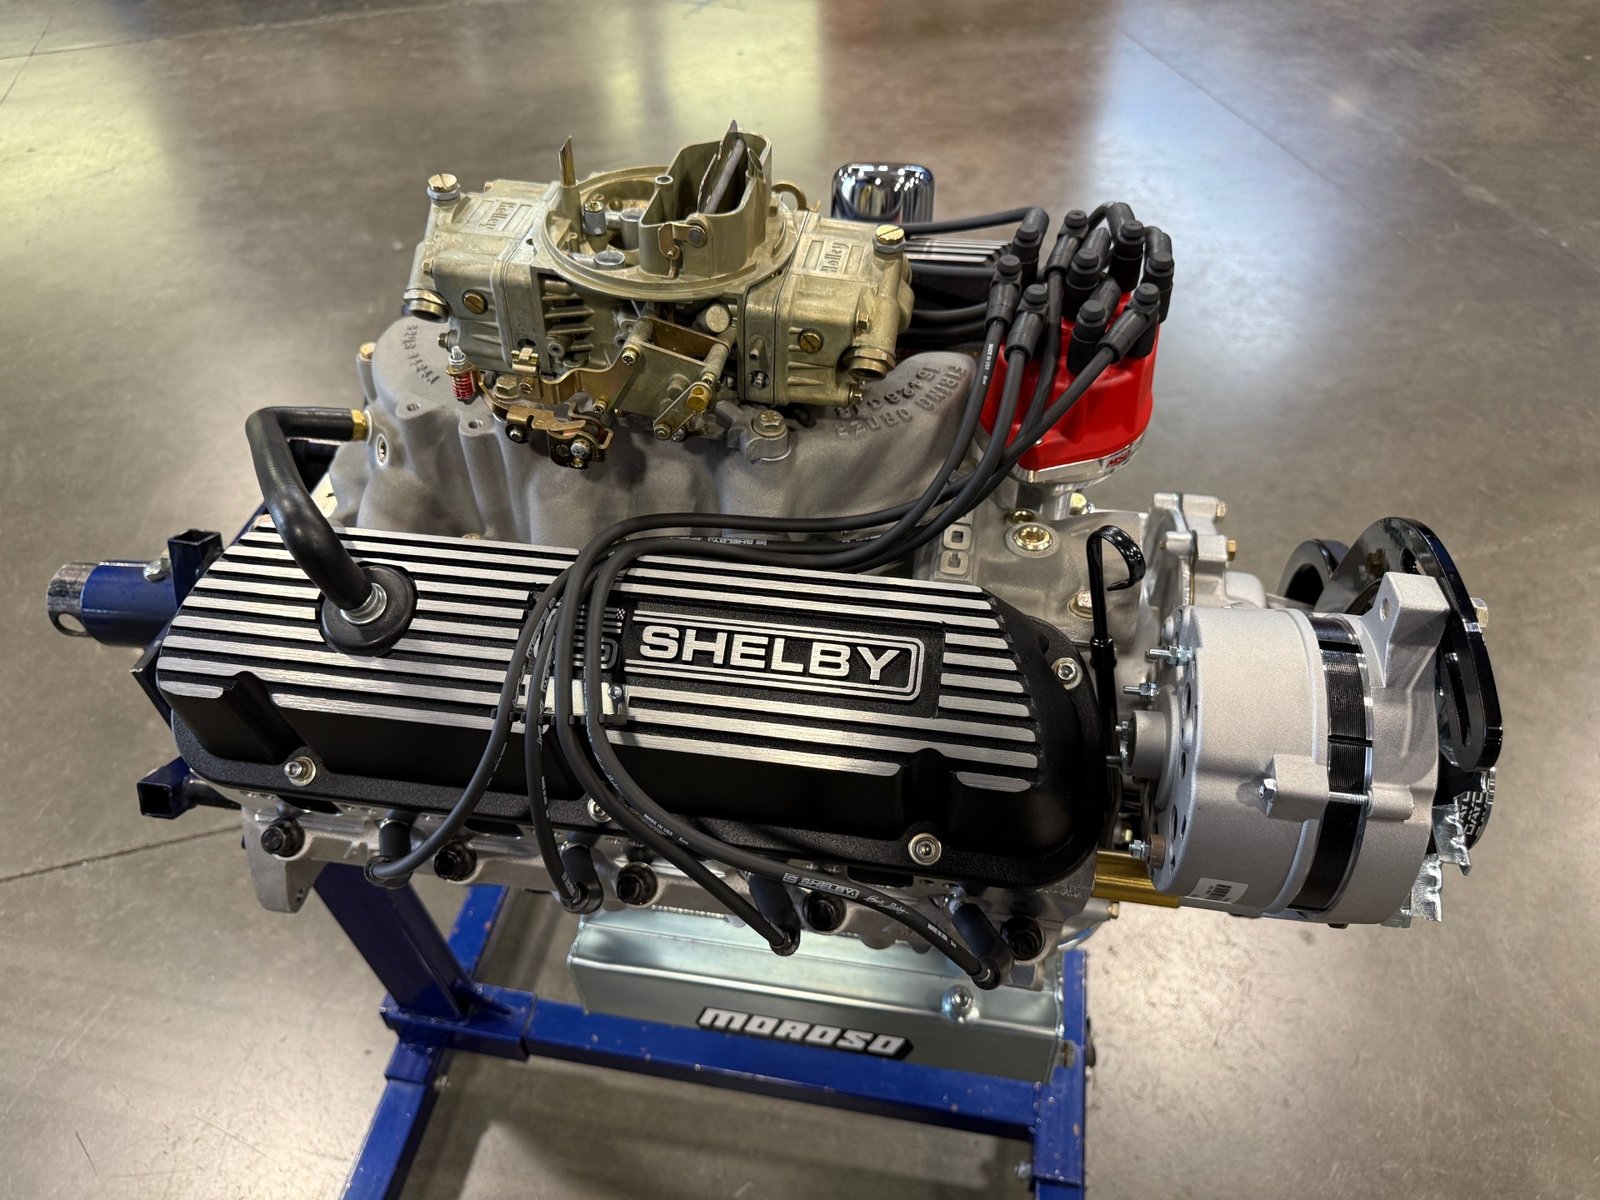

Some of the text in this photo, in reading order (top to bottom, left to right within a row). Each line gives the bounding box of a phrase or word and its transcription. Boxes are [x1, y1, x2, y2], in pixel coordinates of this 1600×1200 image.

[820, 242, 849, 272] Holley
[639, 624, 901, 682] SHELBY
[699, 1007, 907, 1056] MOROSO
